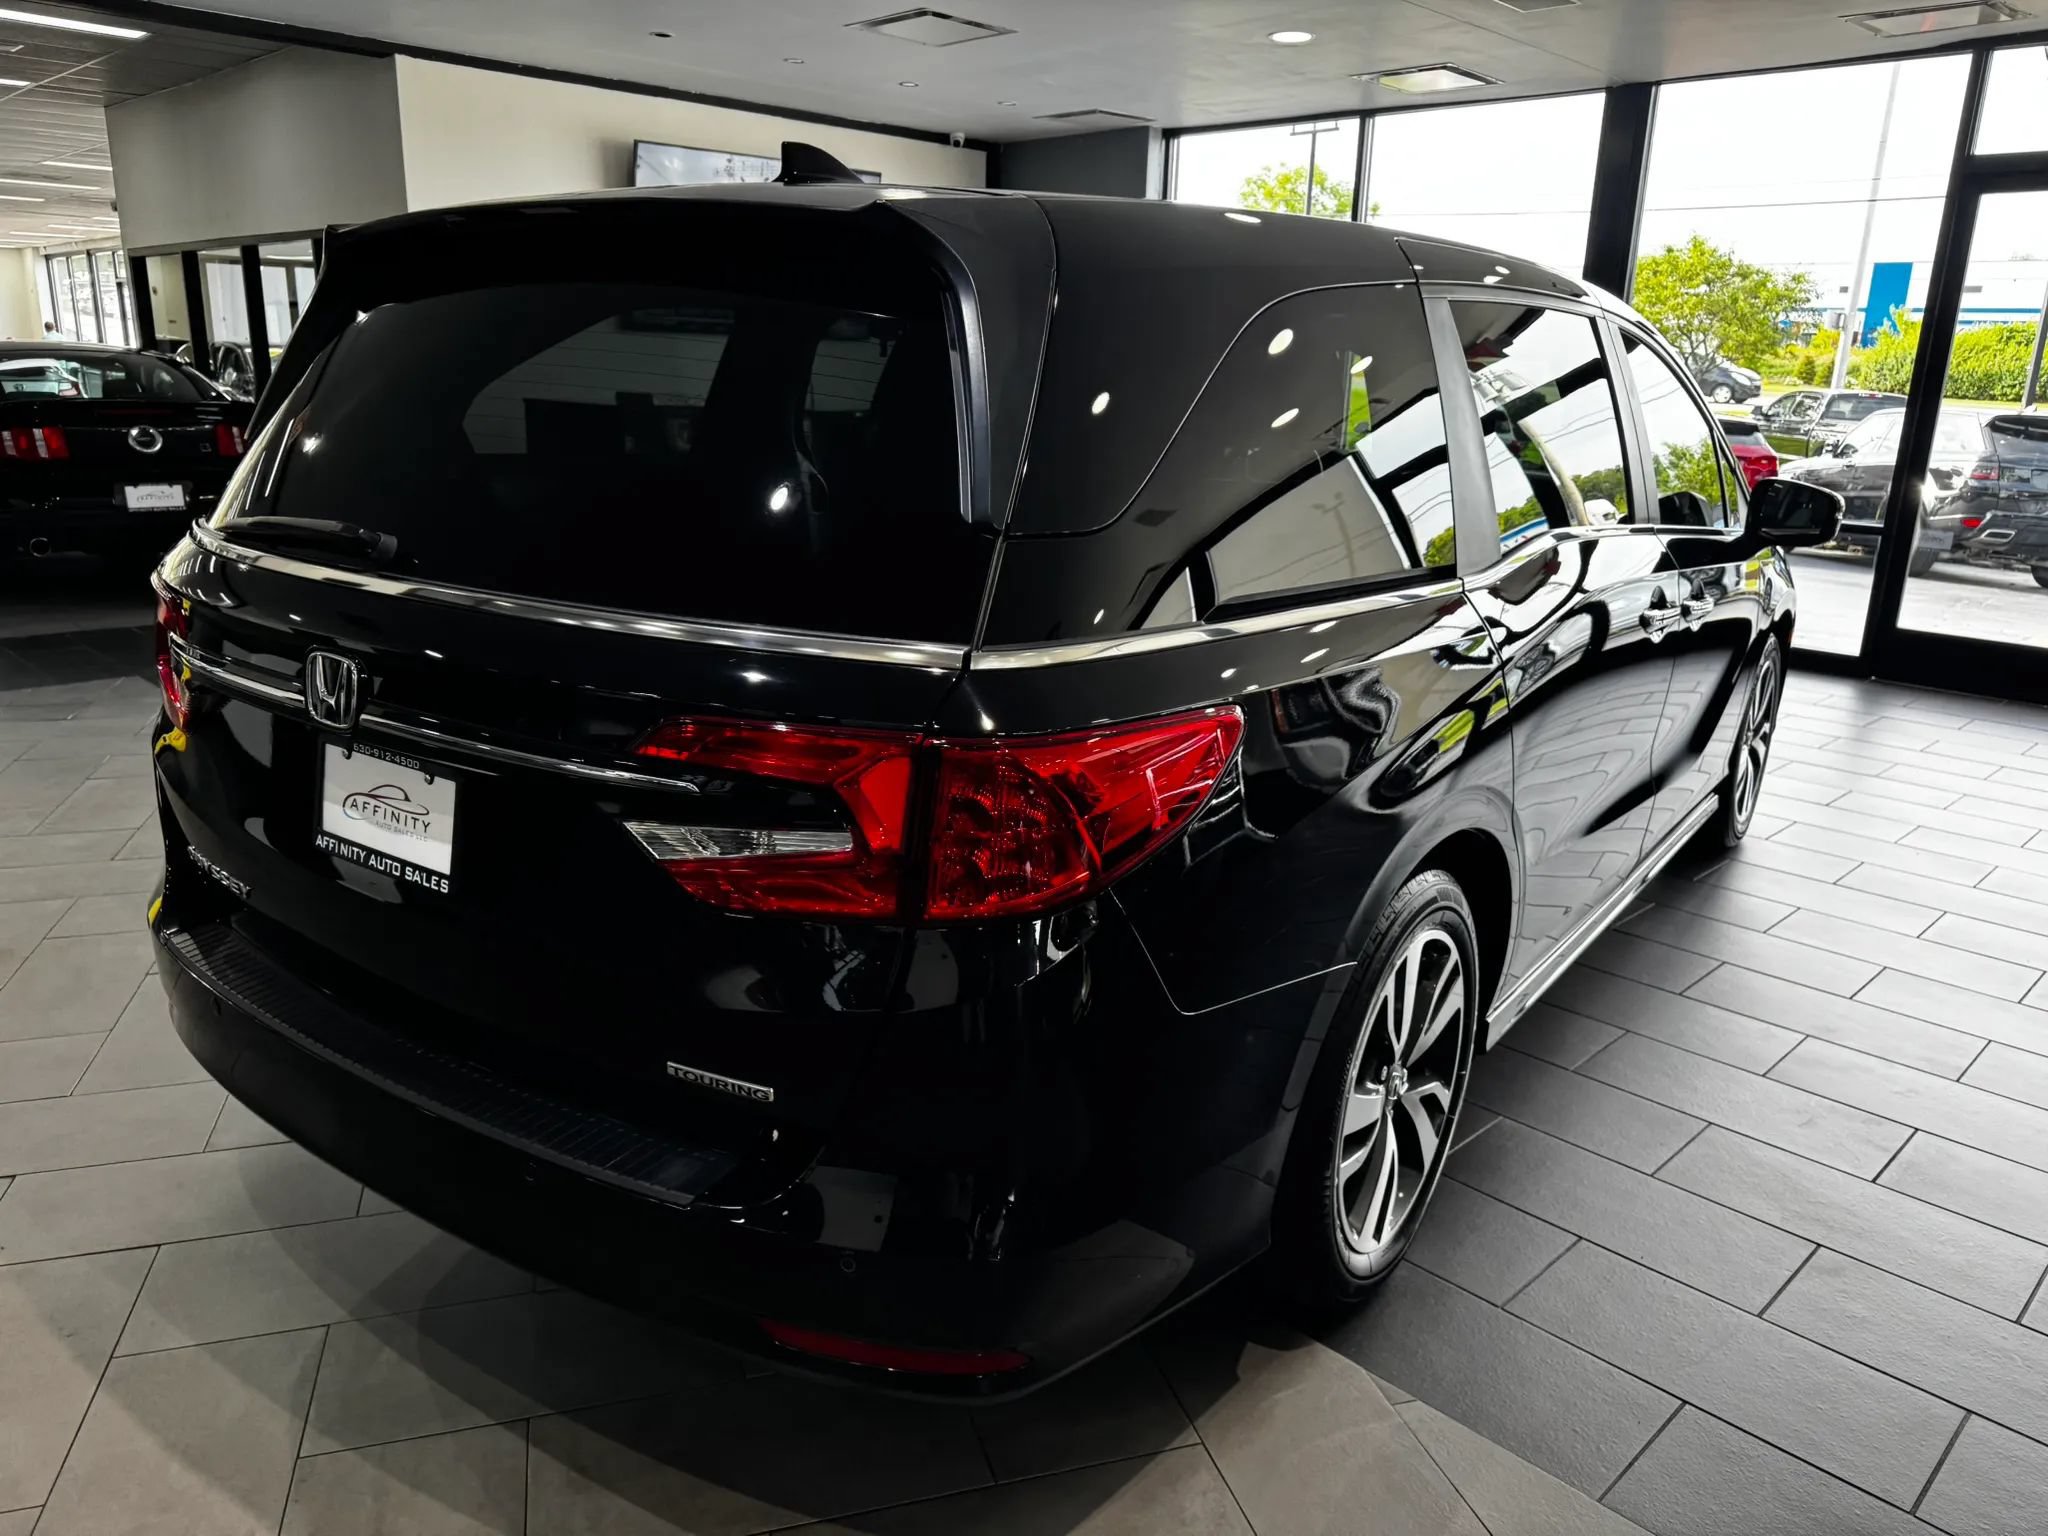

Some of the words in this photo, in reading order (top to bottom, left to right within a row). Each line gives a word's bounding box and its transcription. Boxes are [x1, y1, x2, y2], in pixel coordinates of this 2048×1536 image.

[353, 743, 420, 769] 630-912-4500
[350, 797, 431, 833] AFFINITY
[375, 820, 392, 831] AUTO
[315, 834, 367, 863] AFFINITY
[368, 854, 401, 877] AUTO
[404, 866, 449, 894] SALES
[668, 1063, 772, 1102] TOURING
